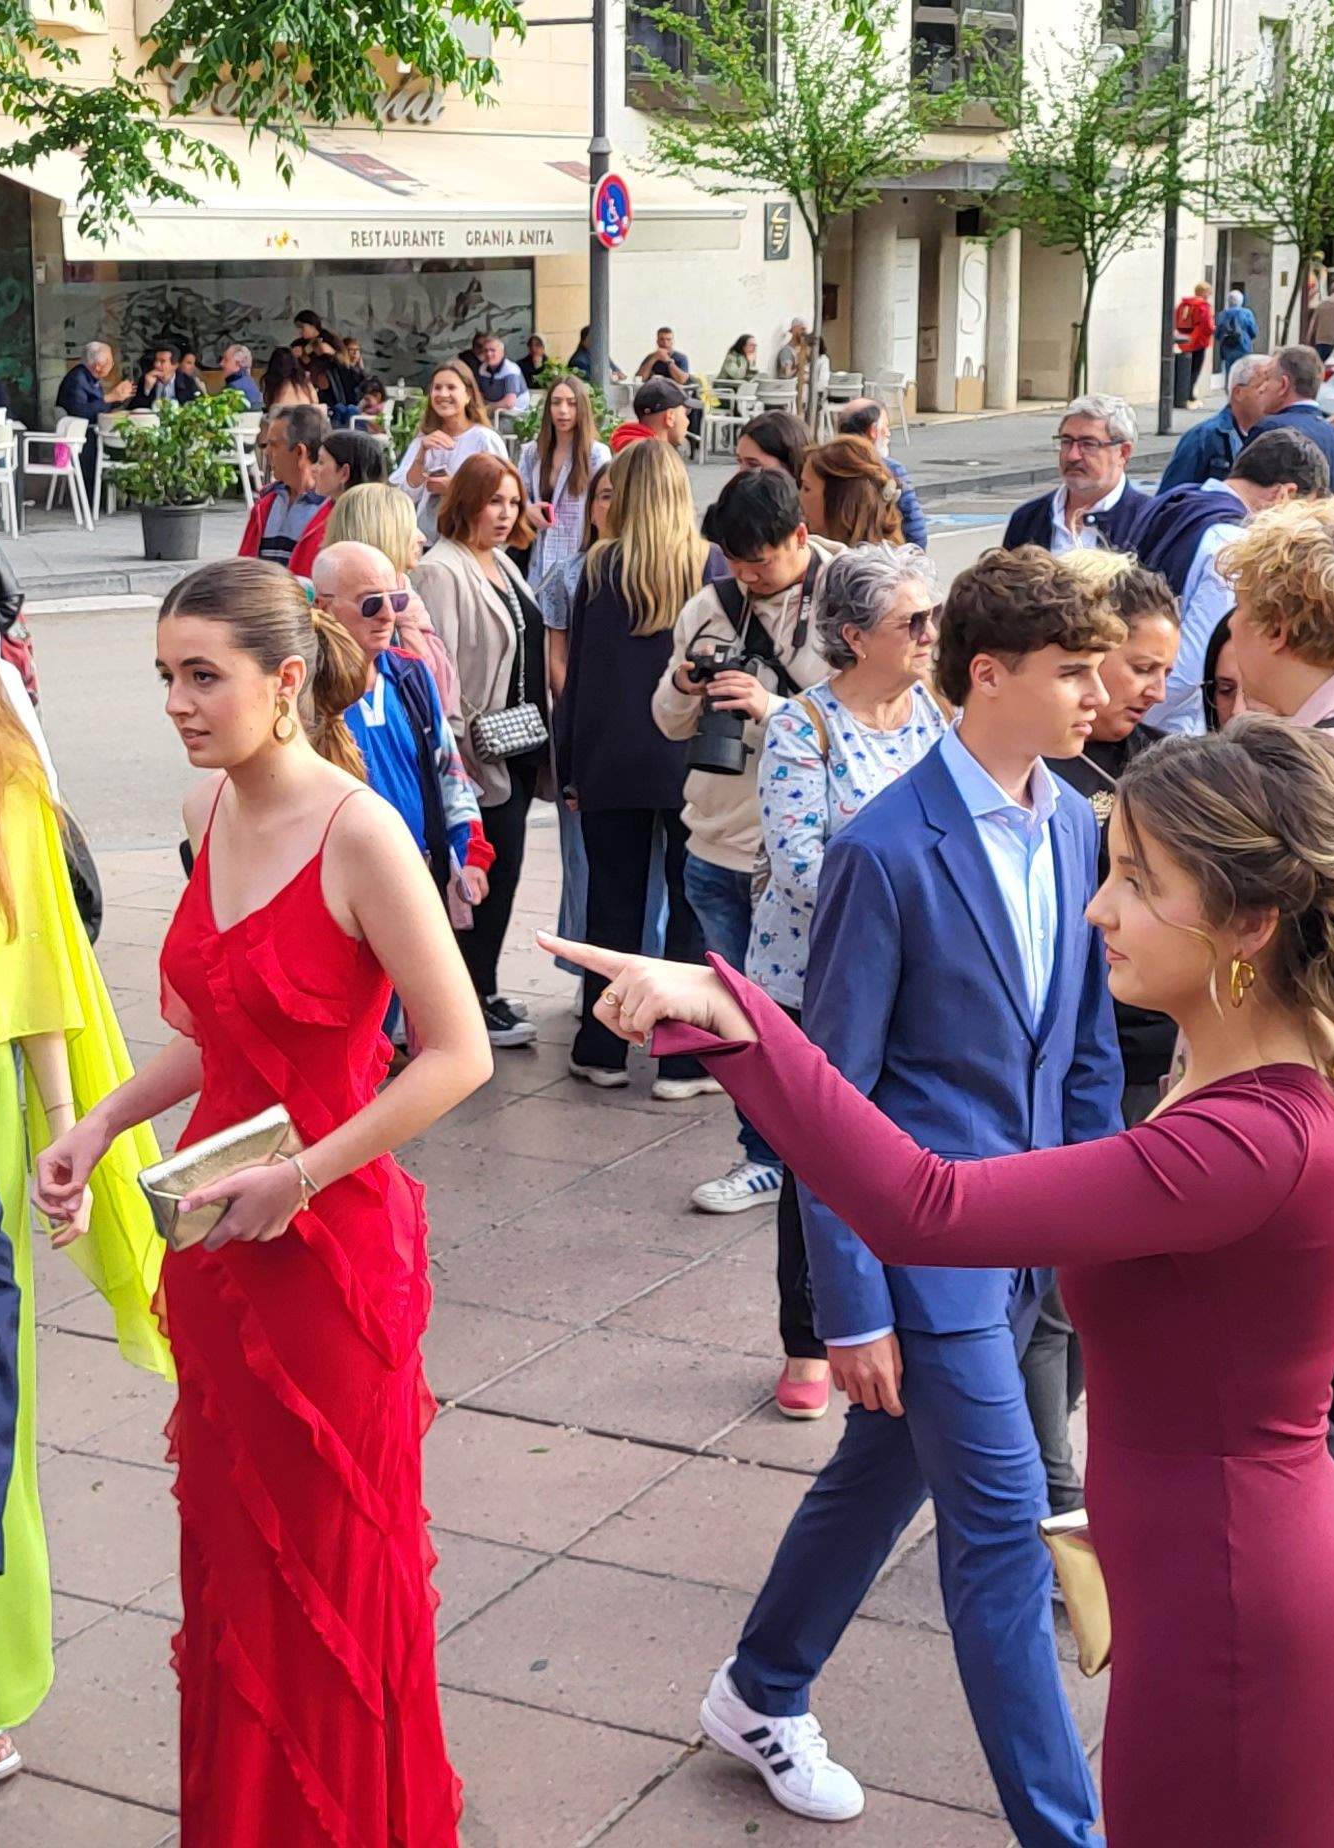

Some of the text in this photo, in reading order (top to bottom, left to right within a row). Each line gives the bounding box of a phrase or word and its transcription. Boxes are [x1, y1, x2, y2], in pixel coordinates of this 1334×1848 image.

[350, 229, 555, 248] RESTAURANTE GRANJA ANITA
